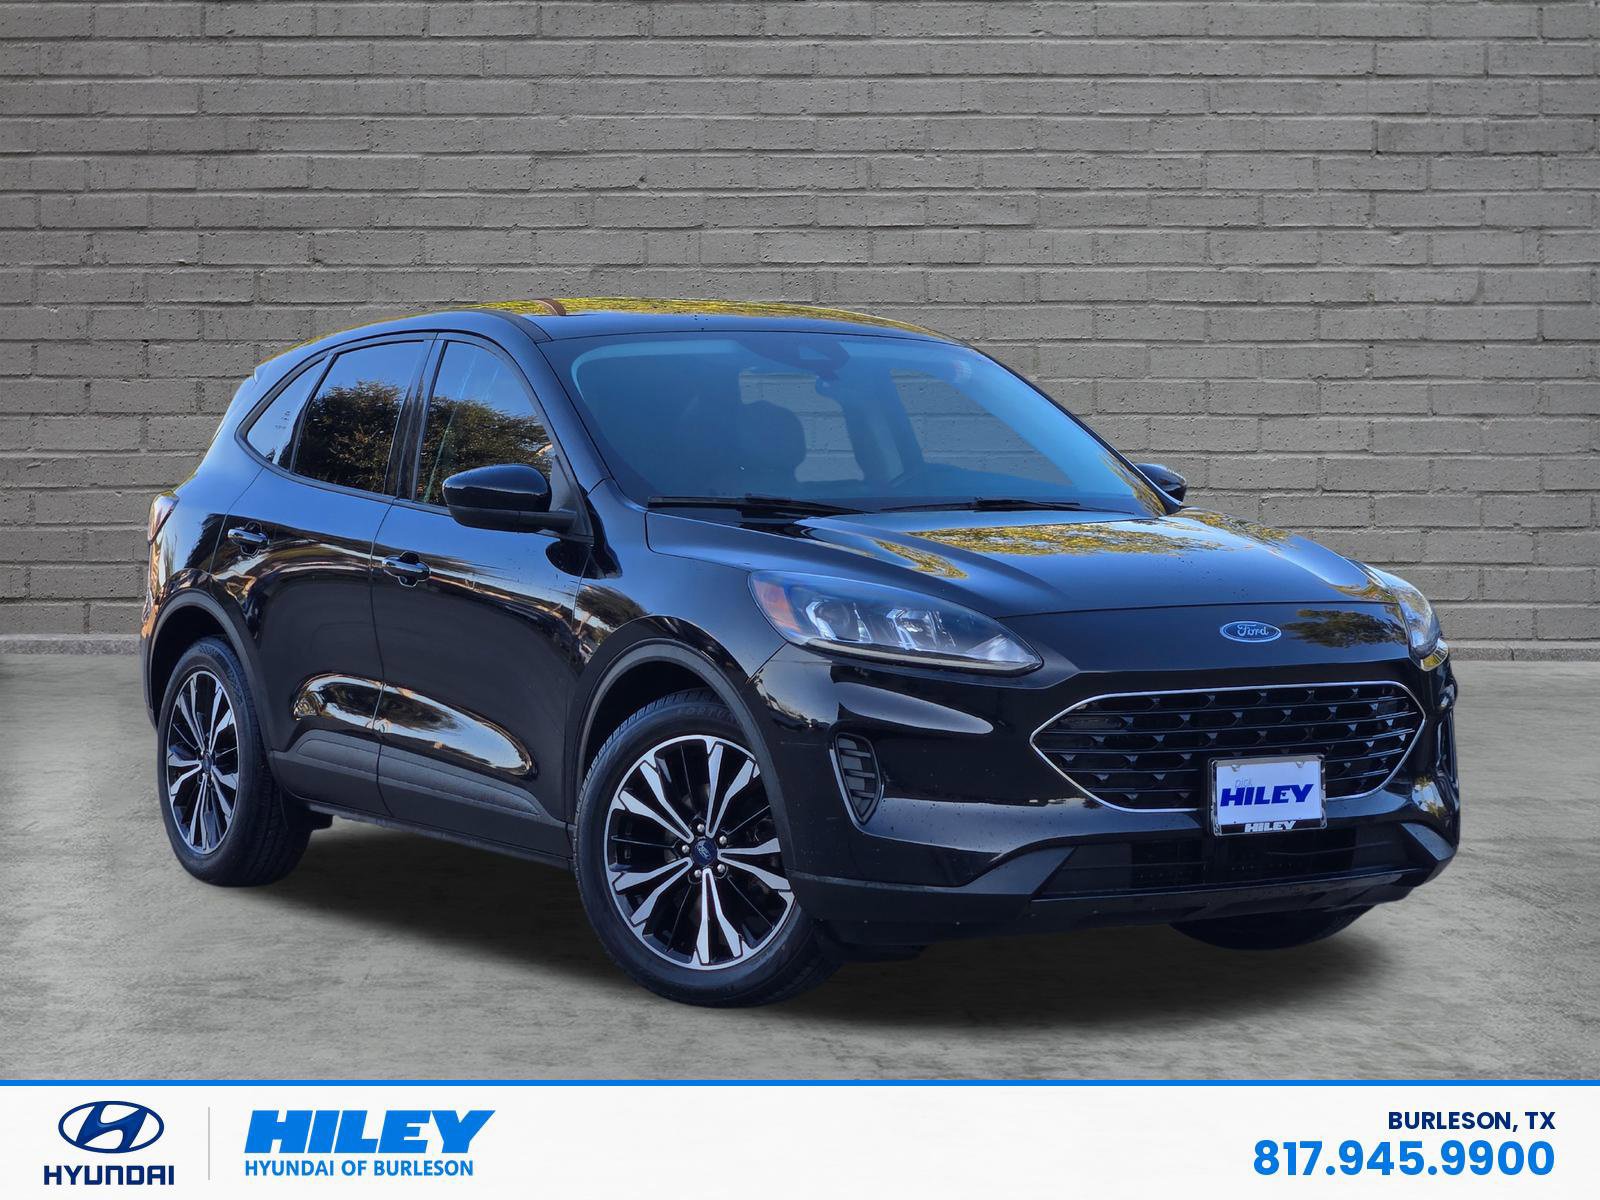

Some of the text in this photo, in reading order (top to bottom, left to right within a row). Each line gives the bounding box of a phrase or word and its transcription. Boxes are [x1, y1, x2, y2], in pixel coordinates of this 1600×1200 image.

[1237, 623, 1269, 636] Ford
[1220, 784, 1314, 807] HILEY
[1244, 820, 1296, 833] HILEY
